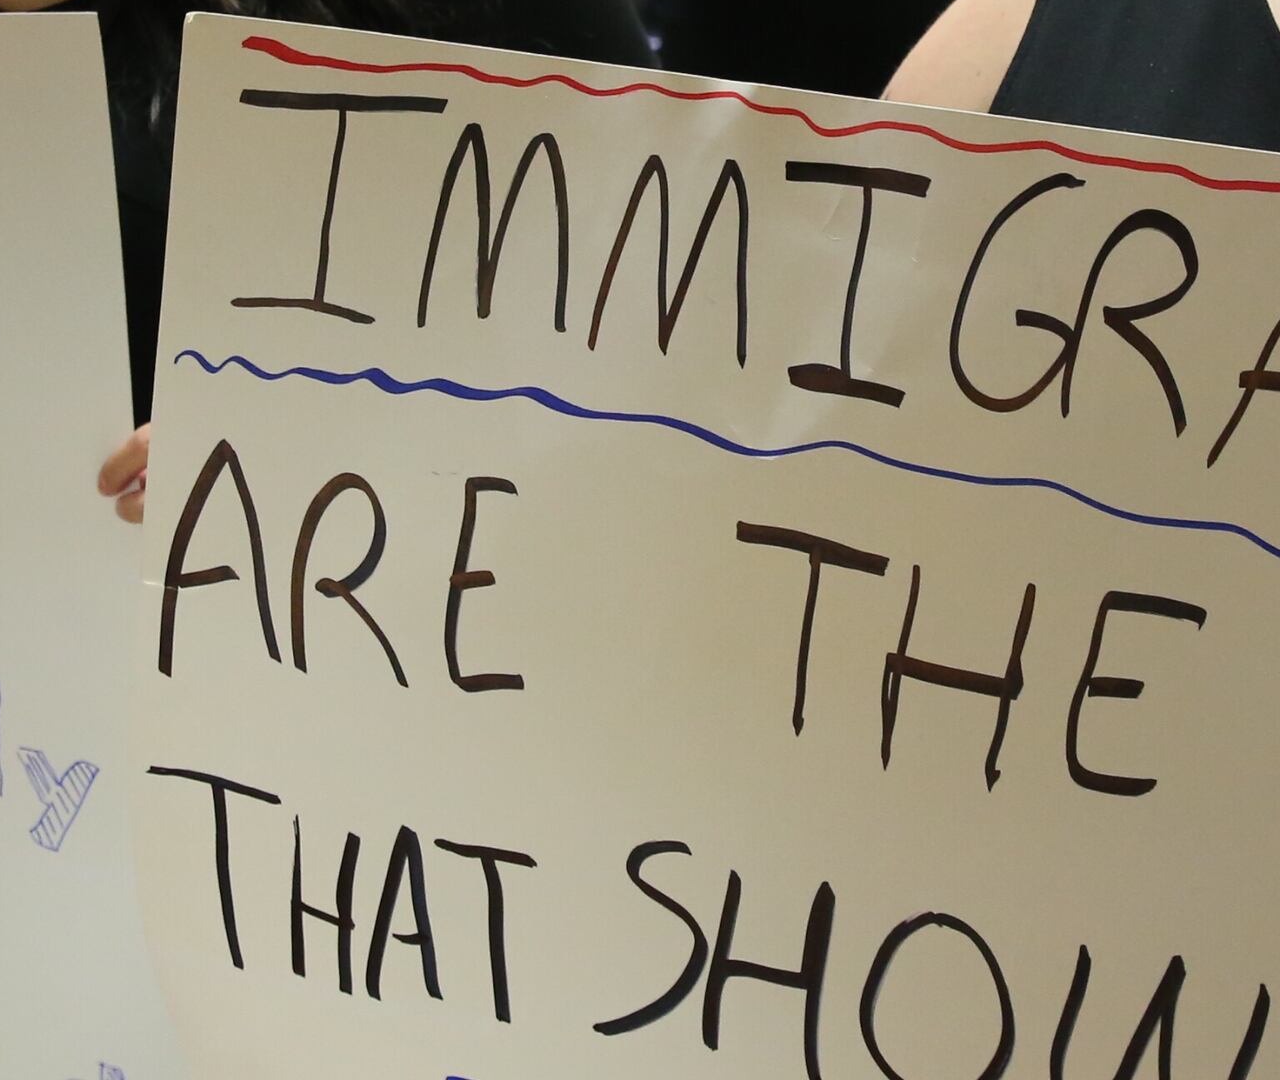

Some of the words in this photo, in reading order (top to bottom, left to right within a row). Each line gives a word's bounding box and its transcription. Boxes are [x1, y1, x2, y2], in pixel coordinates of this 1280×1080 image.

[157, 439, 525, 693] ARE
[735, 521, 1207, 797] THE
[145, 765, 537, 1024] THAT
